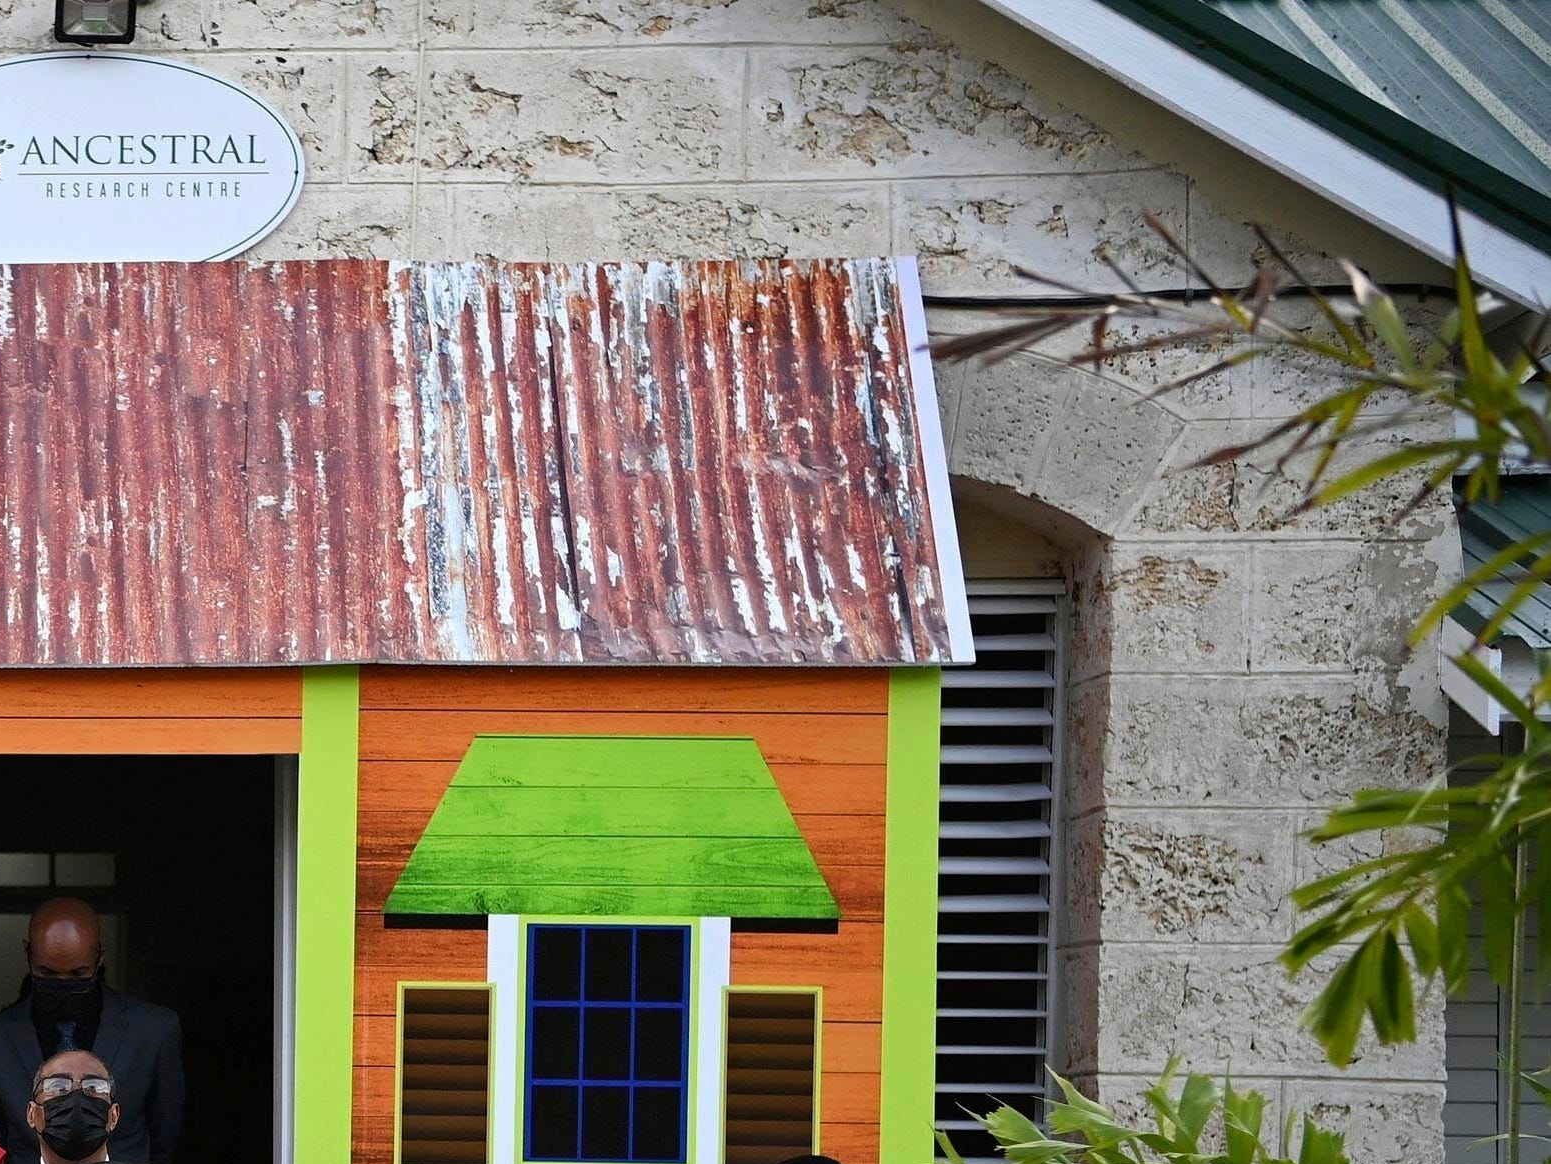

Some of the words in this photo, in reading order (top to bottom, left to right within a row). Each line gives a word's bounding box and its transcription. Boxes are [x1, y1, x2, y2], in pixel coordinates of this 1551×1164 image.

[20, 134, 266, 166] ANCESTRAL
[46, 181, 150, 199] RESEARCH
[166, 180, 242, 198] CENTRE
